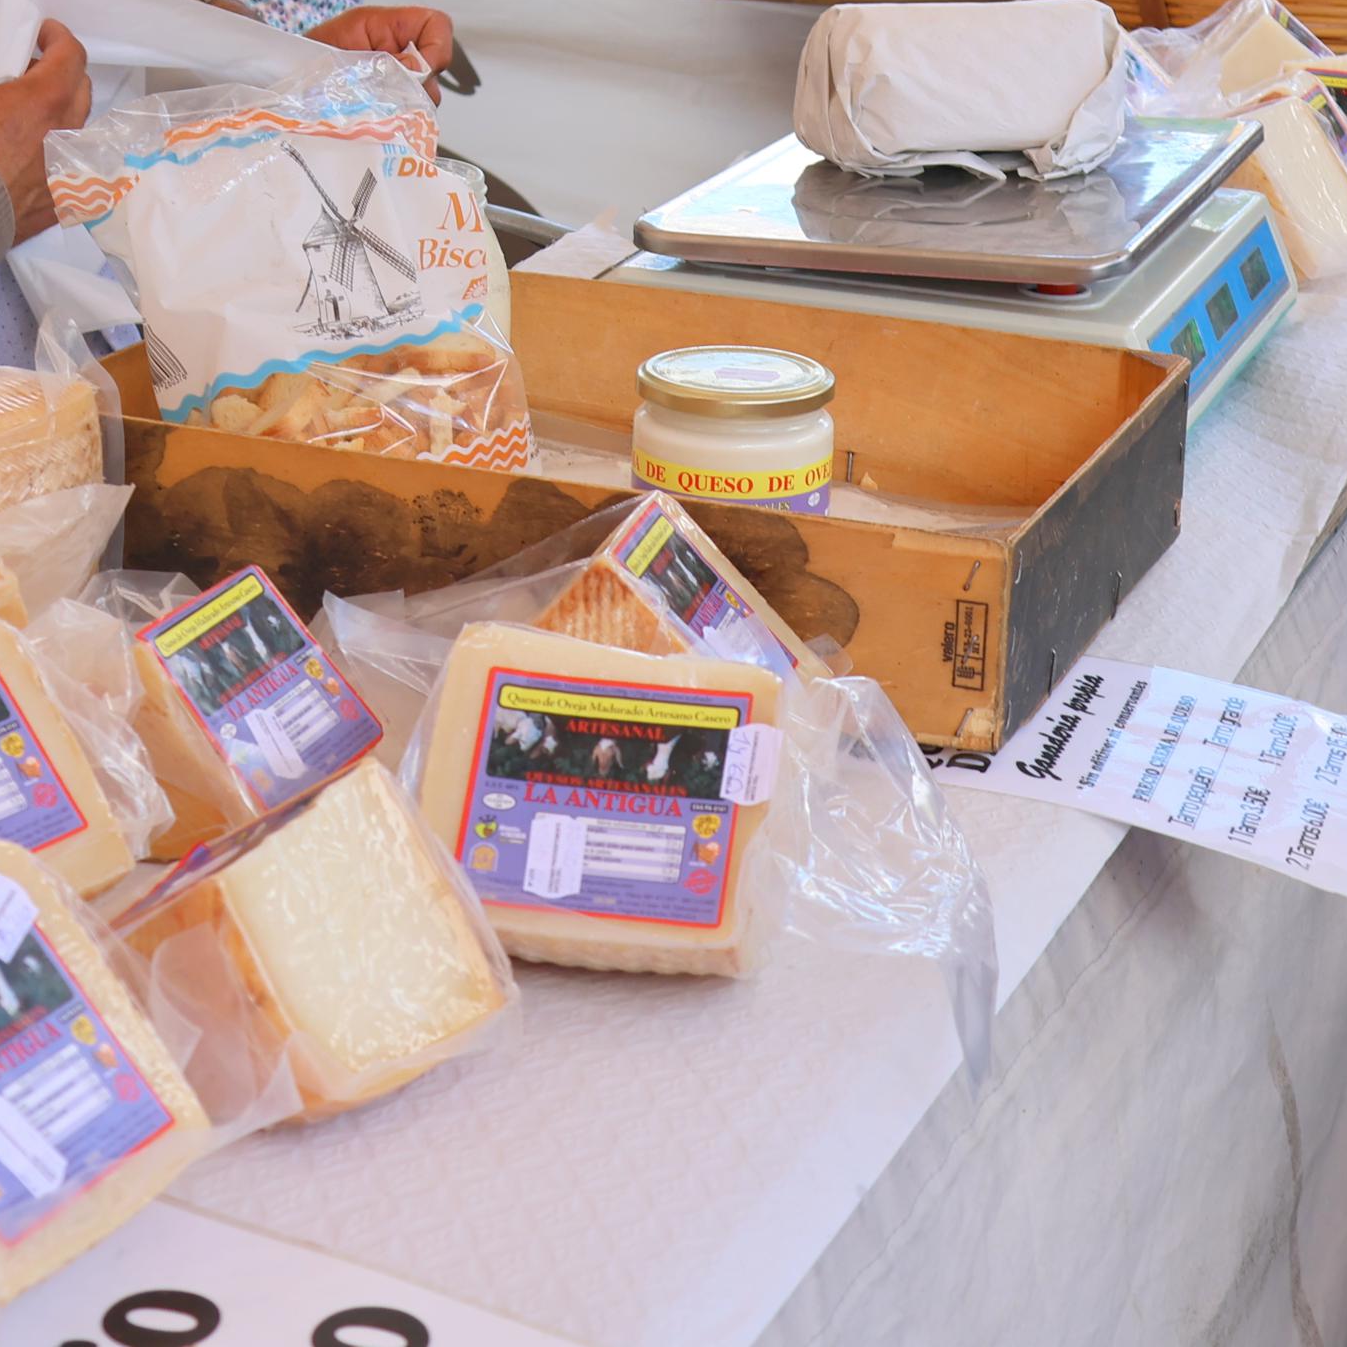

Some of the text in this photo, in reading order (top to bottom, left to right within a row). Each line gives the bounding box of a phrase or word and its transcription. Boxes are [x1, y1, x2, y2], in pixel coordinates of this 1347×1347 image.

[646, 461, 666, 483] DE
[678, 471, 754, 493] QUESO
[768, 475, 795, 493] DE
[249, 662, 300, 706] ANTIGUA
[1063, 674, 1105, 716] propia
[507, 693, 732, 724] Queso de Oveja Madurado Artesano Casero
[565, 718, 665, 741] ARTESANAL
[1132, 695, 1196, 803] PRECIO CREMA DE QUESO
[523, 782, 557, 805] LA
[563, 788, 683, 818] ANTIGUA
[587, 773, 689, 797] ARTESANALES
